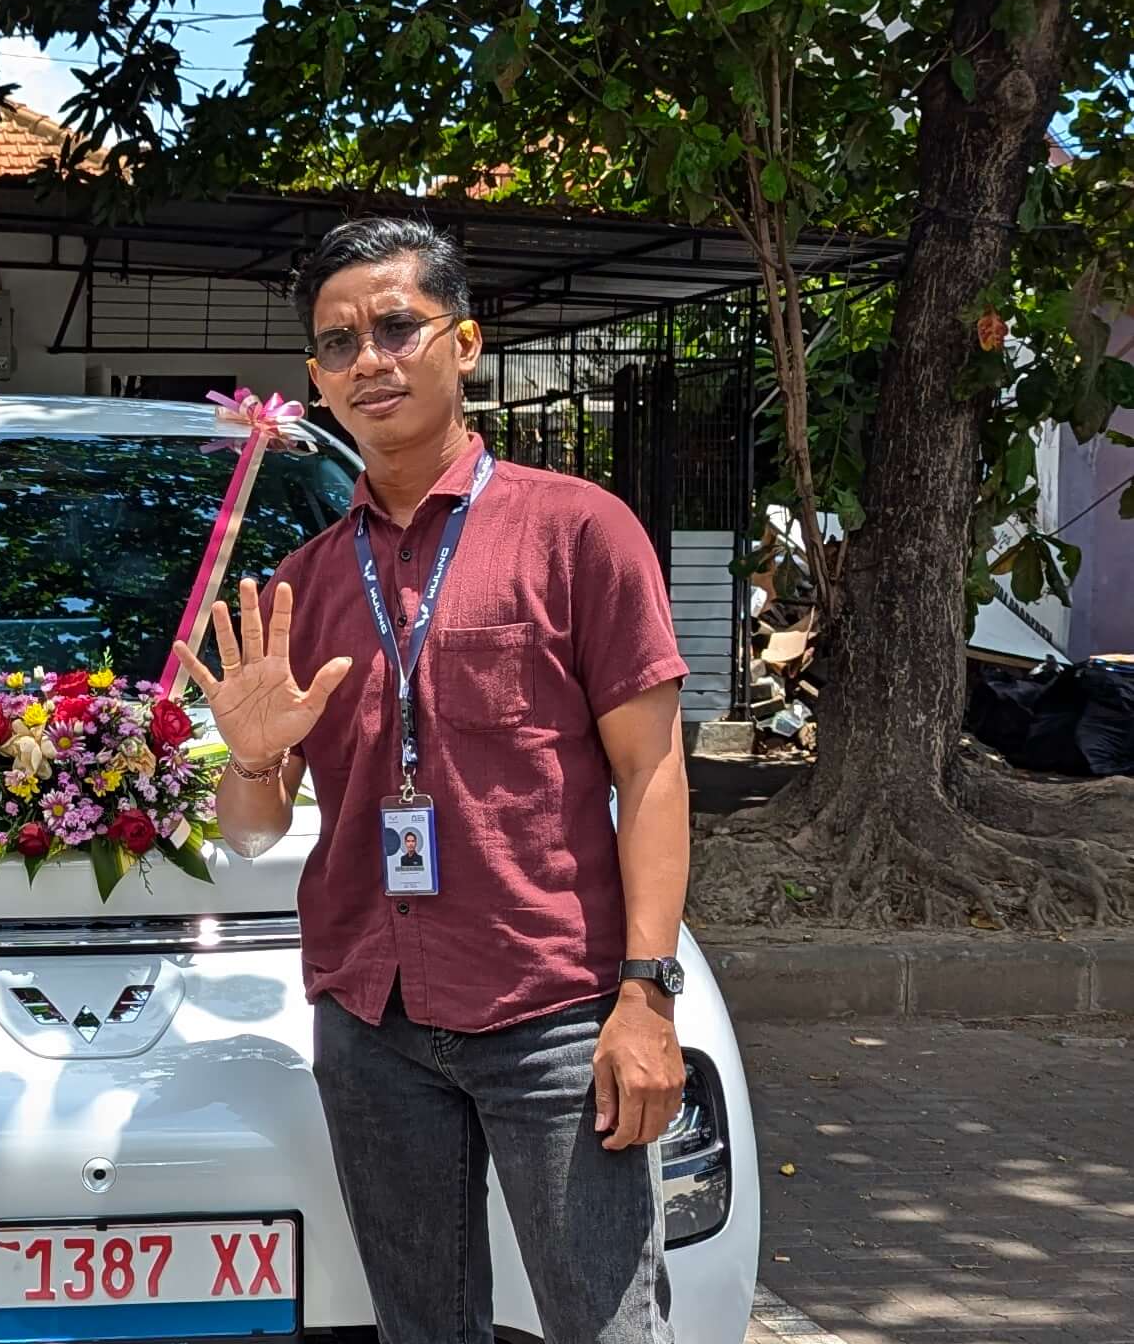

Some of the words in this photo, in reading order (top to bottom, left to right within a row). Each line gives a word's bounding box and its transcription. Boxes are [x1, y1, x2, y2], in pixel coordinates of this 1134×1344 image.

[427, 547, 450, 599] WULING
[369, 587, 389, 635] WULING
[24, 1235, 173, 1301] 1387
[210, 1232, 282, 1297] XX
